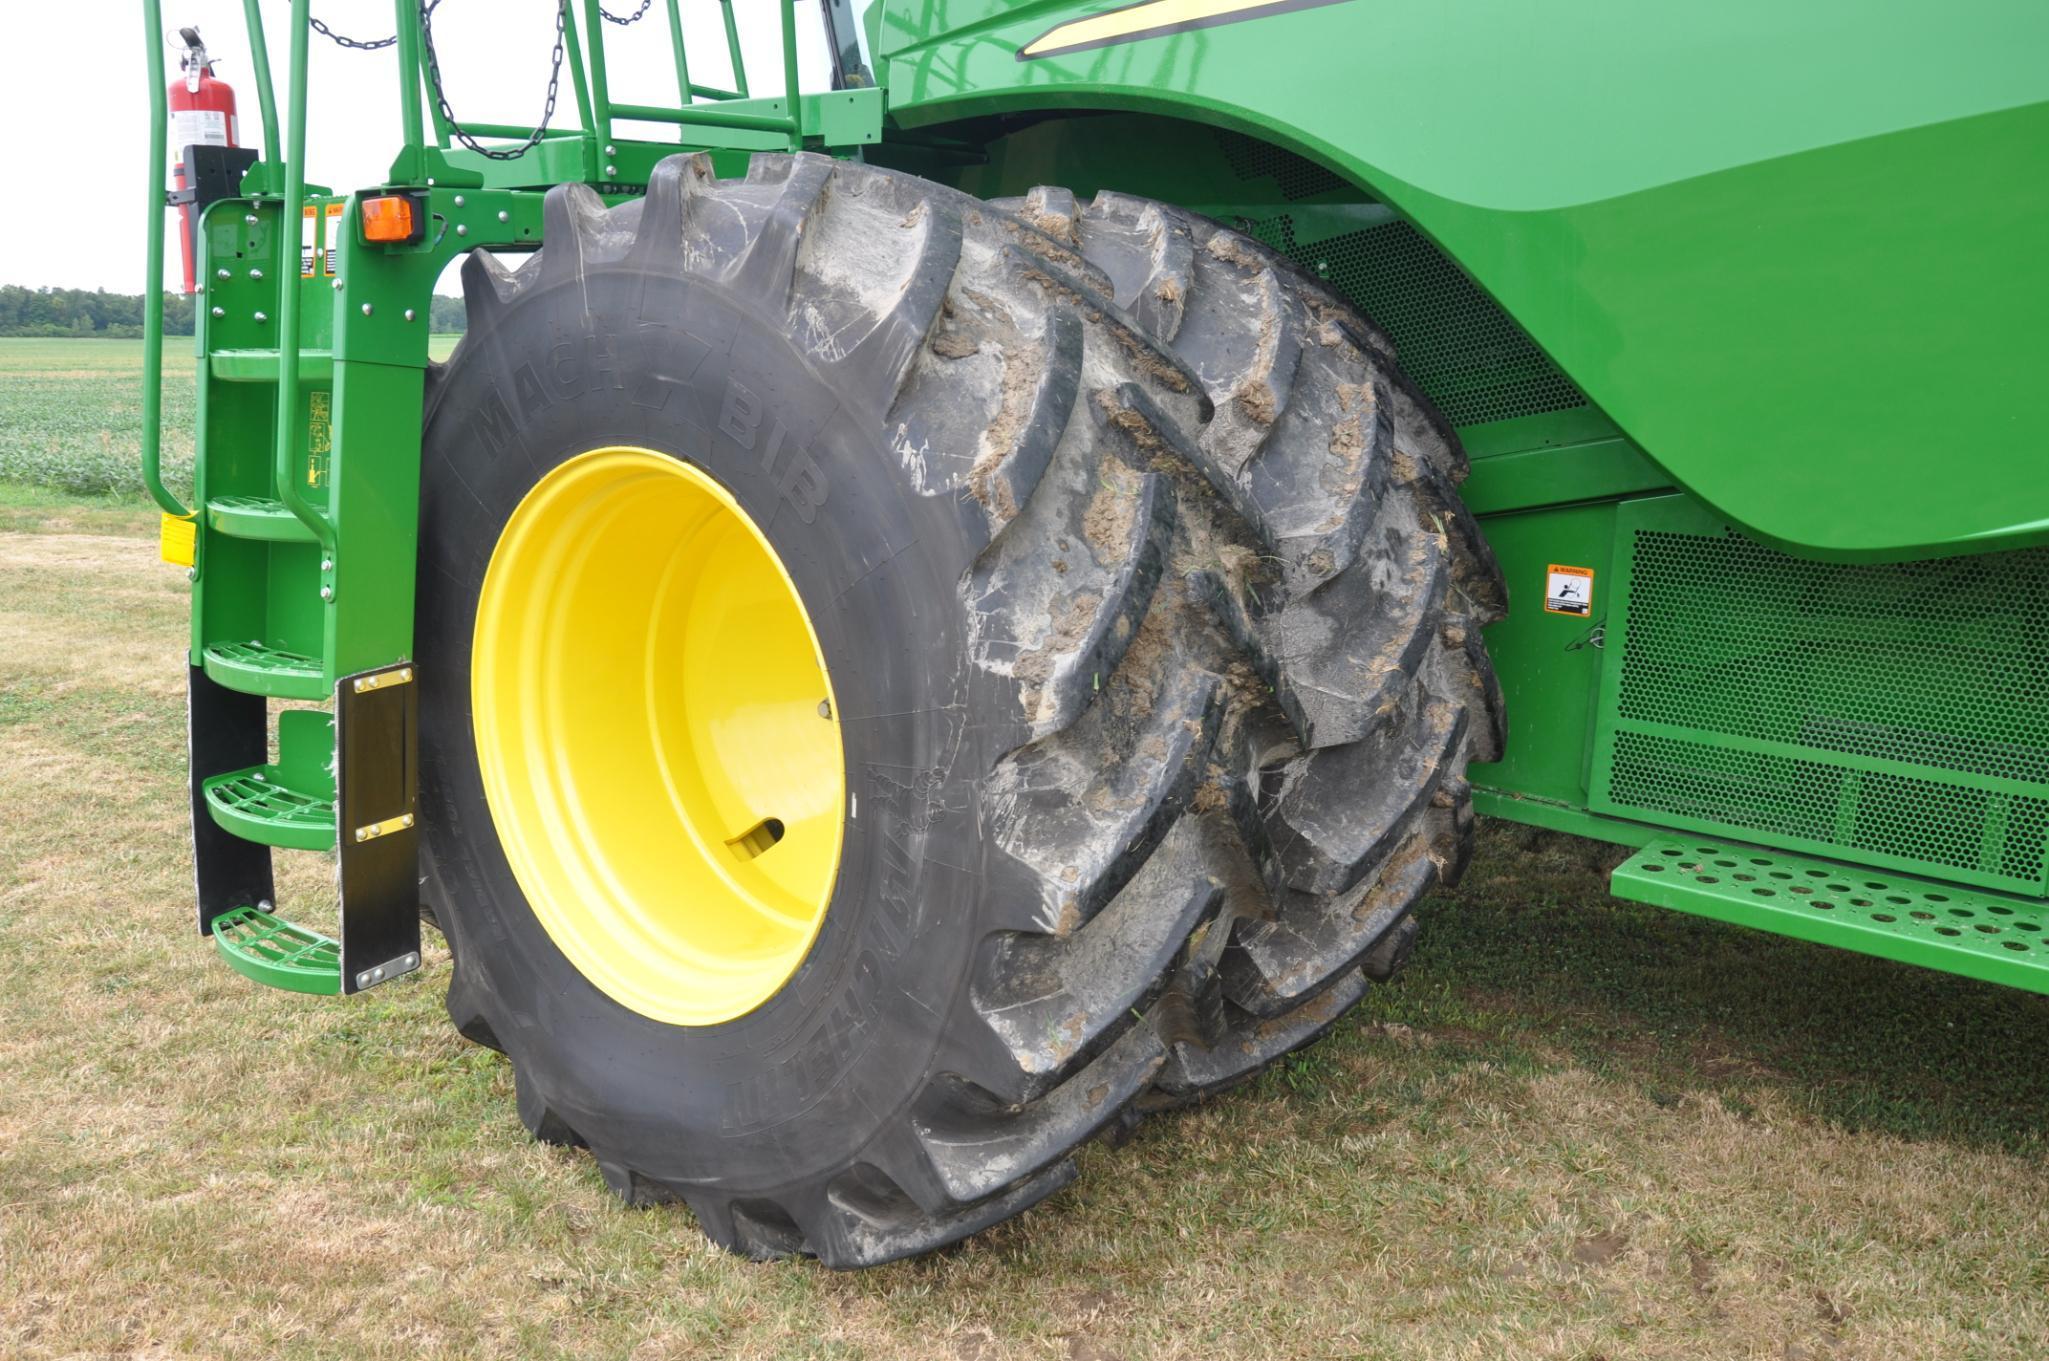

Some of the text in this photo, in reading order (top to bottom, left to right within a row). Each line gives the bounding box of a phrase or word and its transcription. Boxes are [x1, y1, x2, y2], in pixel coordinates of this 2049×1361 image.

[474, 335, 624, 460] MACH
[718, 377, 829, 524] BIB
[1560, 567, 1588, 575] WARNING
